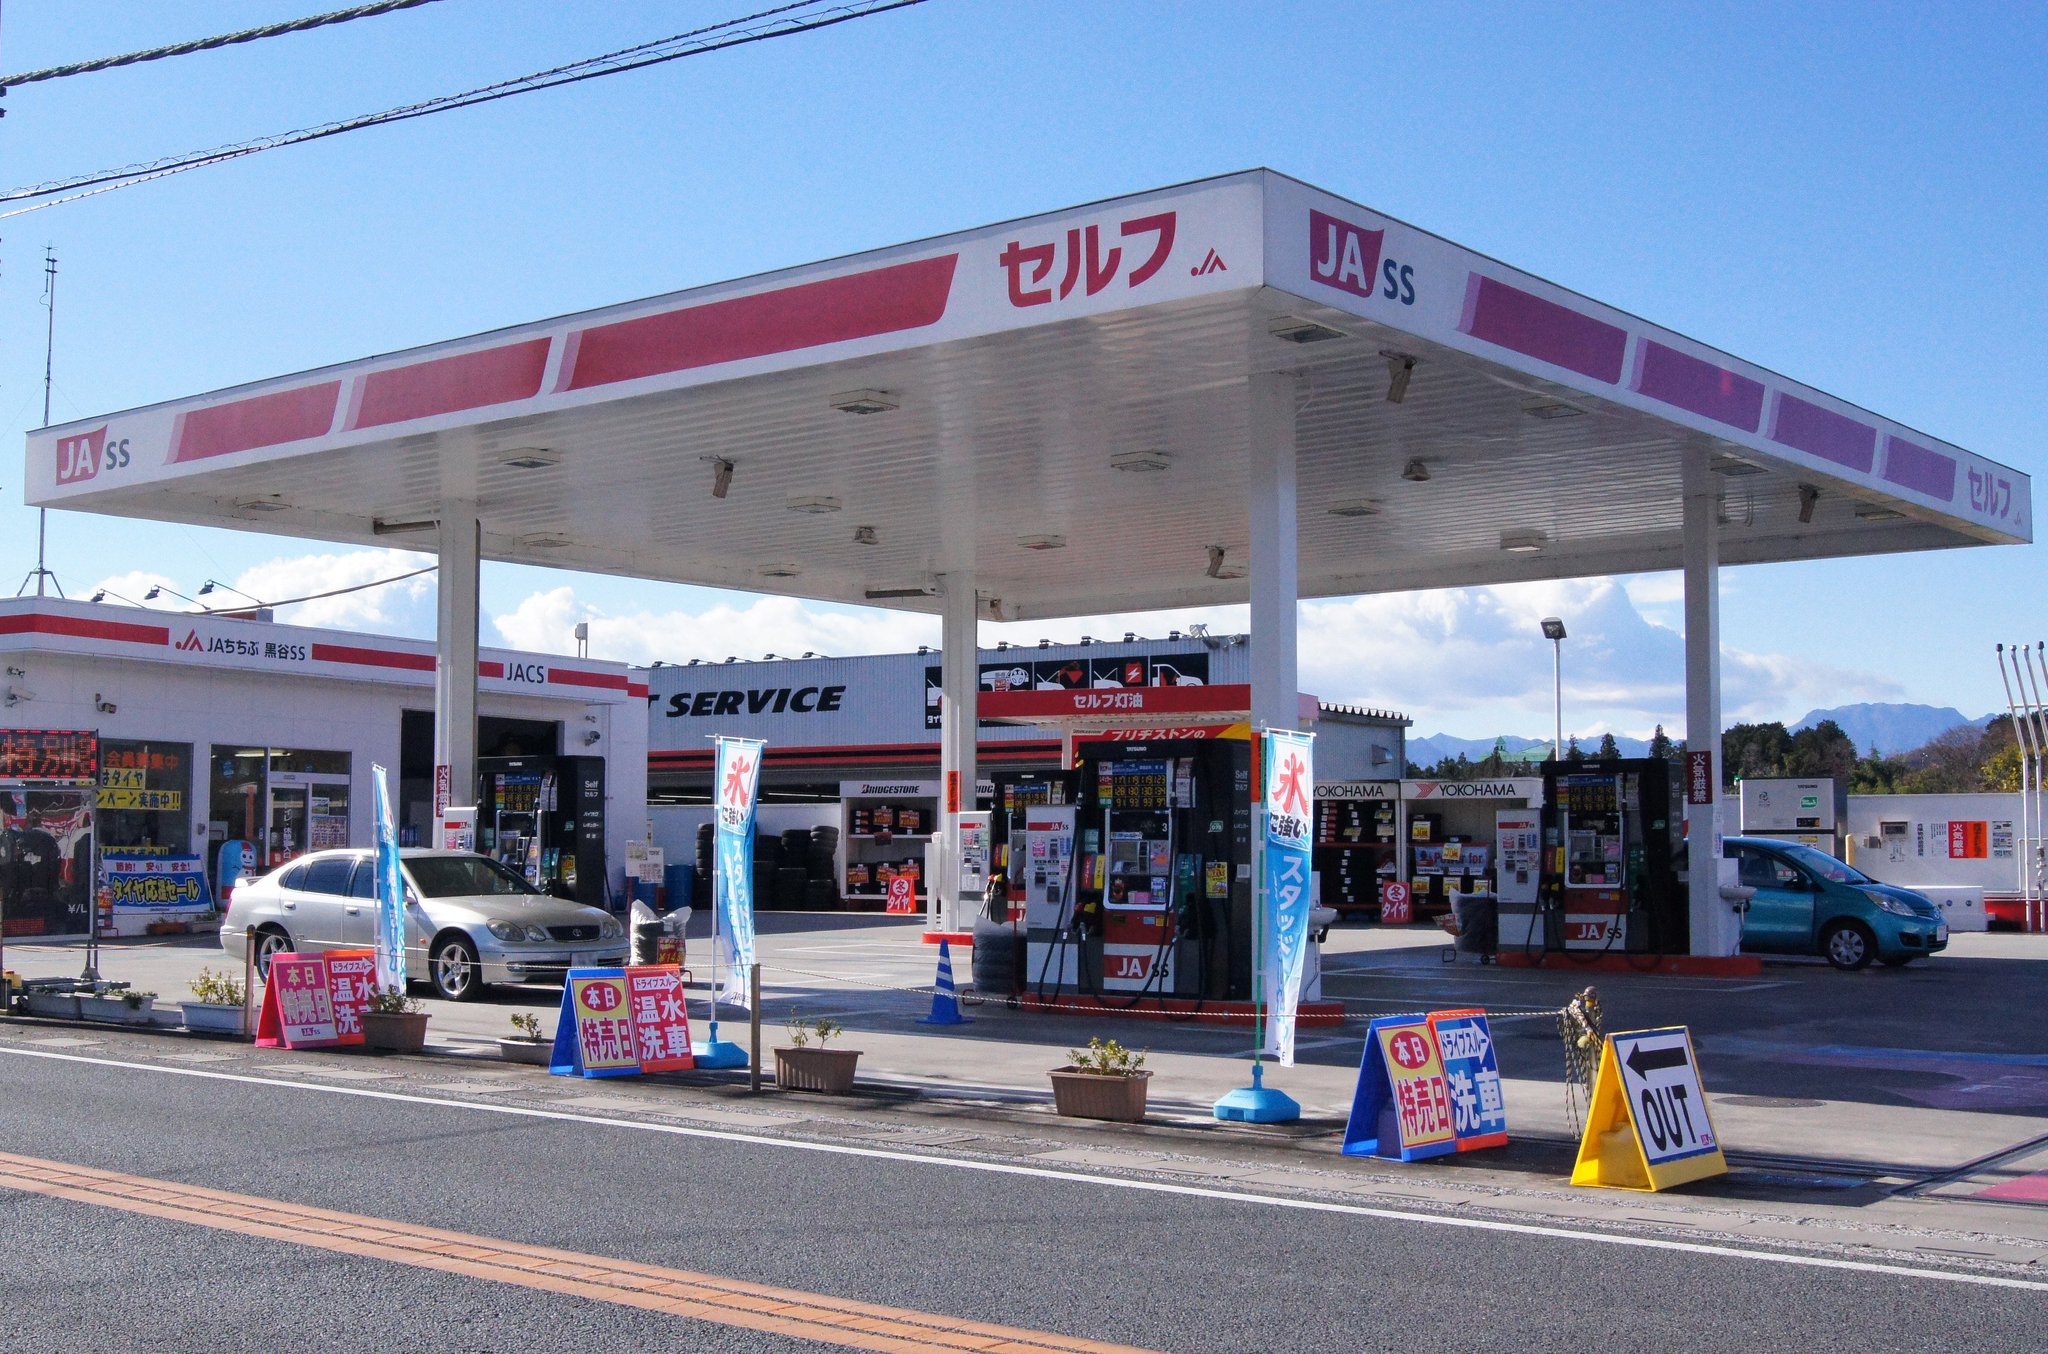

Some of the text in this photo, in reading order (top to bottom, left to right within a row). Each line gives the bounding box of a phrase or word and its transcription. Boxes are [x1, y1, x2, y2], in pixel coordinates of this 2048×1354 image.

[1000, 211, 1177, 308] セルフ
[1318, 224, 1416, 305] JA SS
[61, 438, 130, 480] JA SS
[1967, 465, 2011, 520] セルフ
[206, 636, 259, 656] JAちちぶ
[263, 642, 306, 661] 黒谷SS
[507, 662, 545, 684] JACS
[666, 685, 846, 718] SERVICE
[1074, 692, 1143, 708] セルフ灯油
[723, 755, 751, 807] 氷
[1234, 769, 1249, 779] Self
[1272, 752, 1309, 817] 氷
[1692, 754, 1706, 804] 火気厳禁
[860, 784, 920, 795] BRIDGESTONE
[1313, 785, 1385, 798] YOKOHAMA
[1440, 783, 1516, 797] YOKOHAMA
[1162, 822, 1168, 832] 3
[1270, 811, 1308, 839] に強い
[1952, 823, 1965, 857] 火気厳禁
[1469, 852, 1483, 864] for
[887, 895, 910, 911] タイヤ
[1382, 902, 1409, 919] タイヤ
[1577, 924, 1600, 939] JA
[286, 966, 316, 986] 本日
[333, 962, 374, 974] ドライブスルー
[1117, 958, 1144, 977] JA
[331, 976, 377, 1003] 温水
[586, 986, 616, 1009] 本日
[635, 977, 679, 991] ドライブスルー
[280, 987, 332, 1024] 特売日
[634, 993, 686, 1024] 温水
[581, 1017, 635, 1063] 特売日
[638, 1023, 690, 1060] 洗車
[1394, 1035, 1426, 1066] 本日
[1440, 1030, 1487, 1059] ドライブスルー
[1397, 1076, 1450, 1138] 特売日
[1448, 1066, 1505, 1133] 洗車
[1641, 1083, 1697, 1152] OUT
